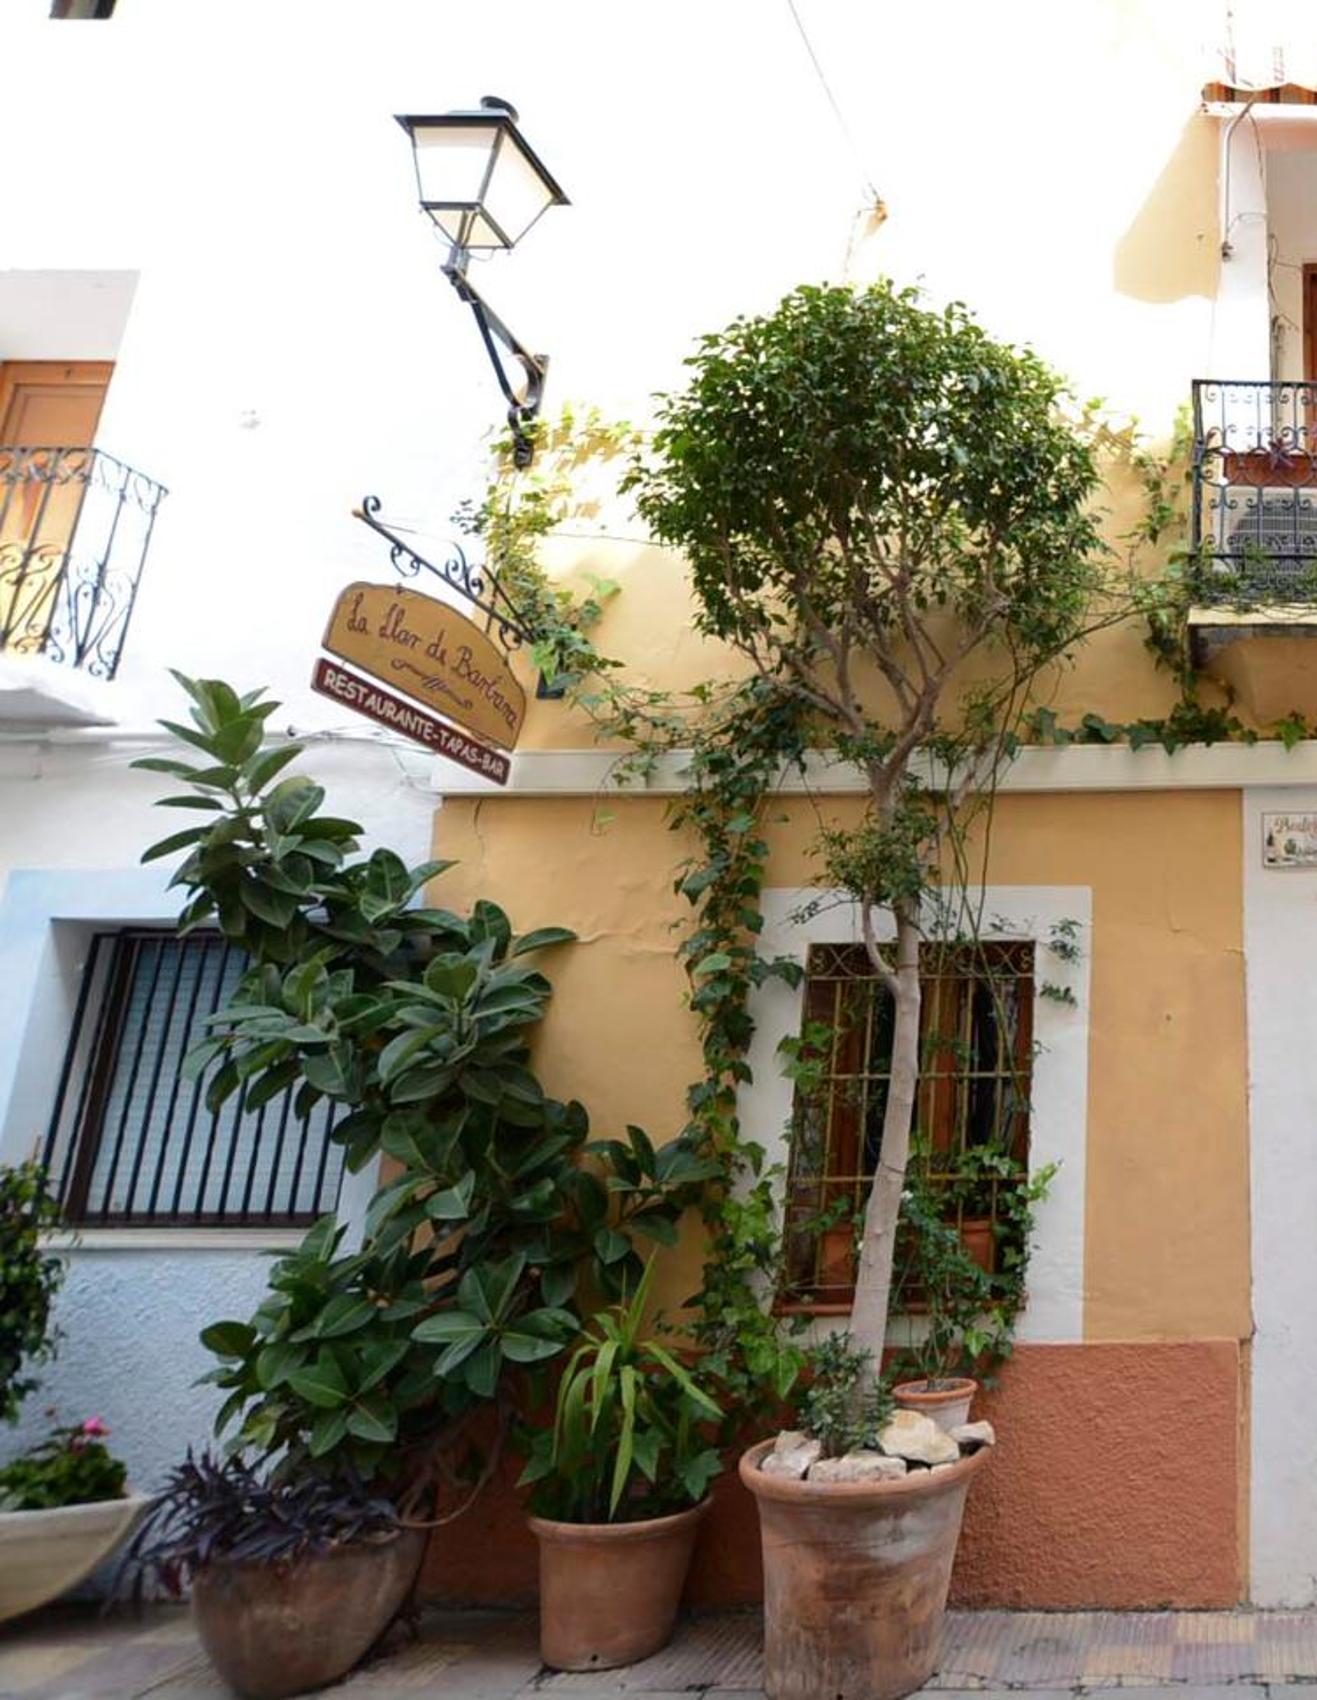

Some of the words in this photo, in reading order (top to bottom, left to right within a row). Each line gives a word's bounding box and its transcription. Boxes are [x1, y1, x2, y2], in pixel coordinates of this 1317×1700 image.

[324, 668, 505, 777] RESTAURANTE-TAPAS-BAR
[347, 592, 369, 635] La
[379, 603, 422, 649] Llar
[426, 629, 448, 666] de
[451, 645, 517, 731] Barbara
